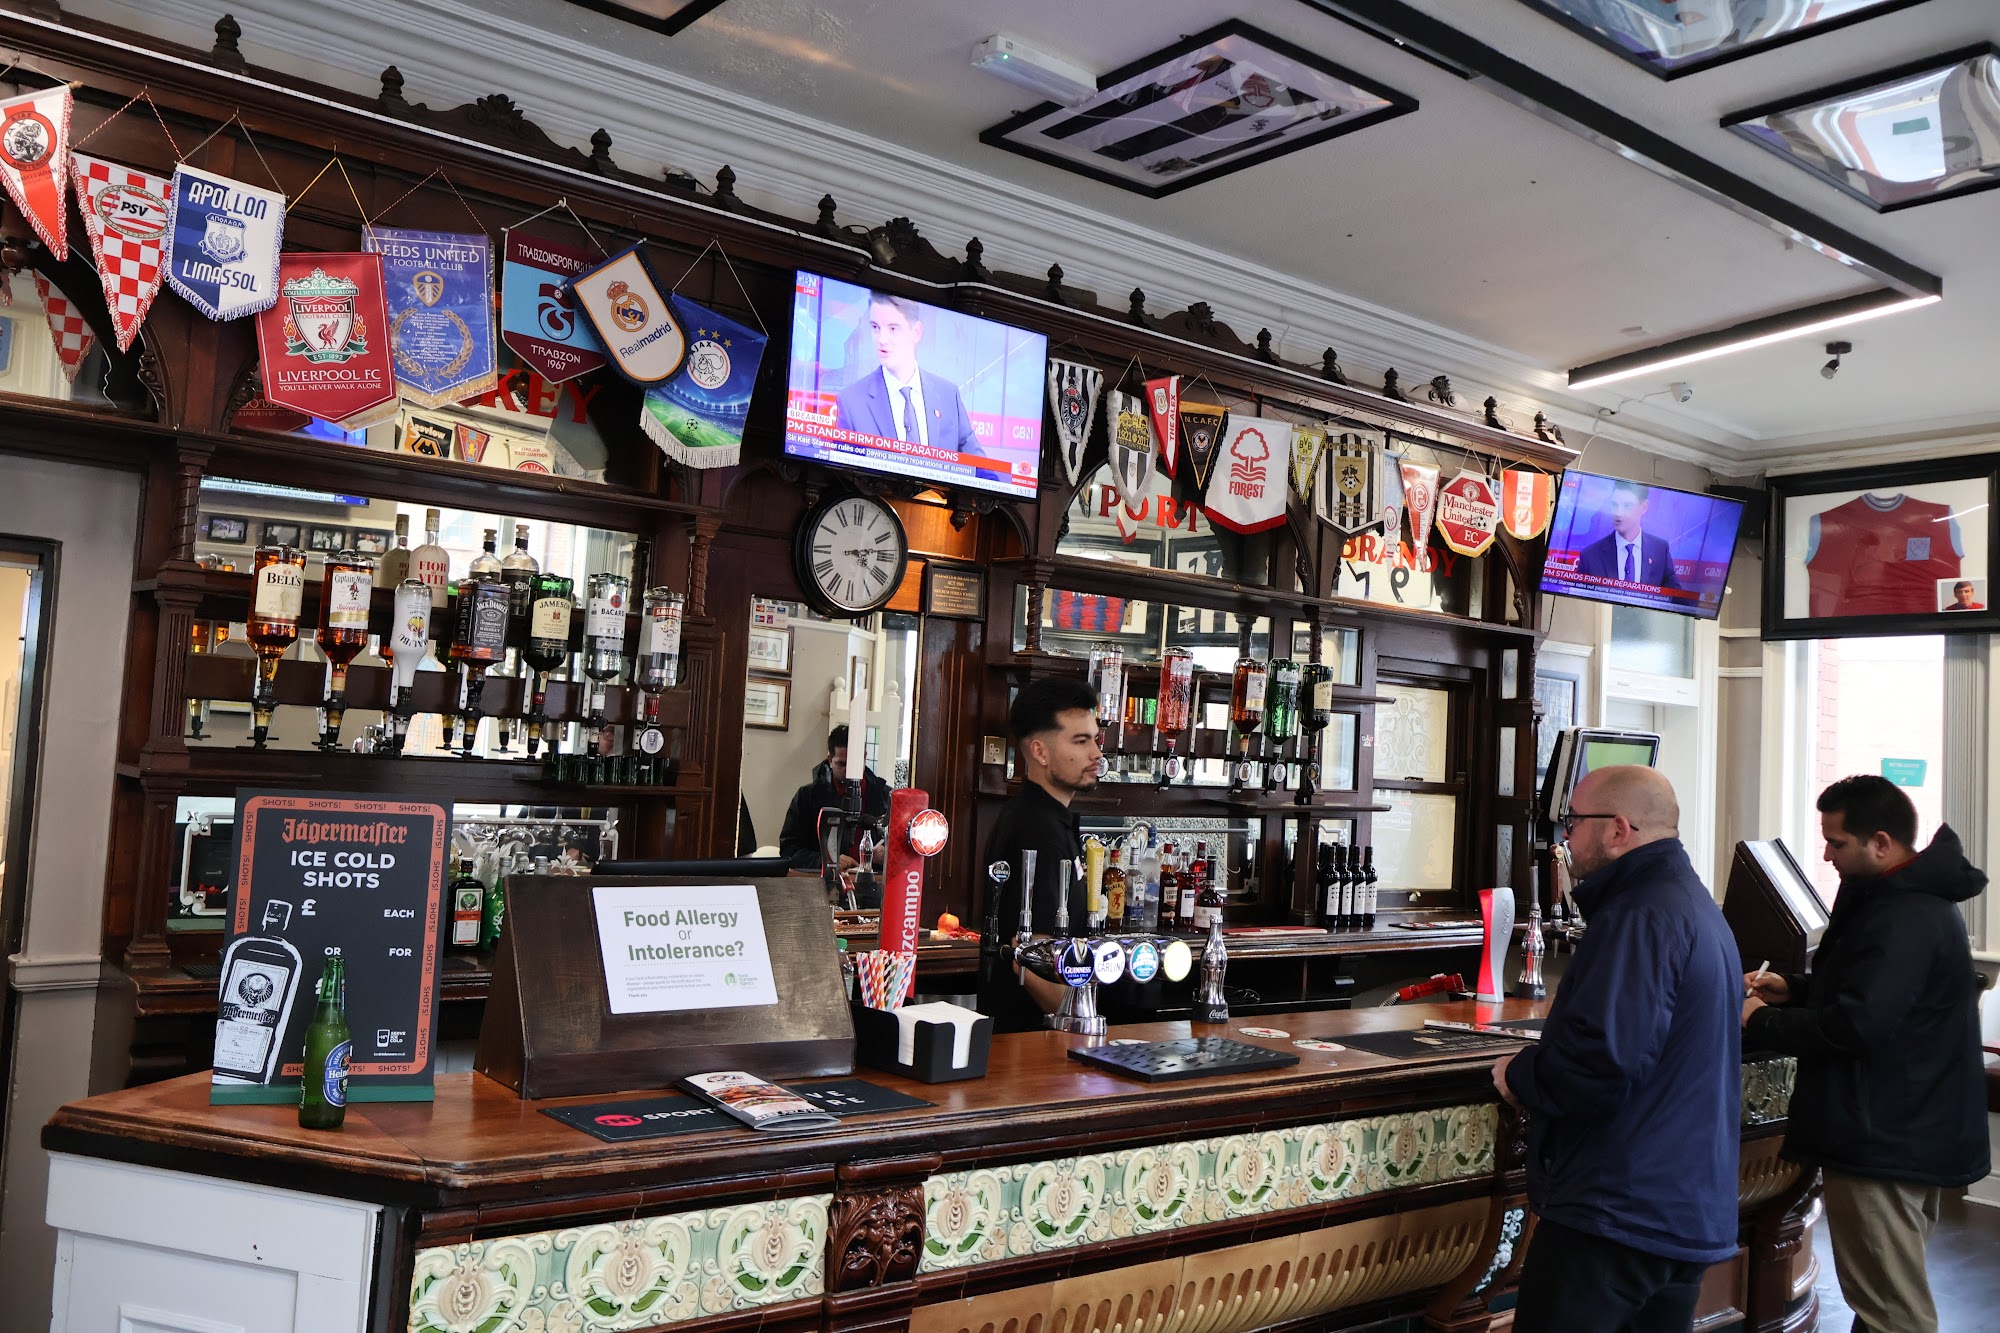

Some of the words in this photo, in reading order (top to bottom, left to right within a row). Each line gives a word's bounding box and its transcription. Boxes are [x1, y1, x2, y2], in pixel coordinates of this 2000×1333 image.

[188, 181, 268, 220] APOLLON
[120, 201, 149, 217] PSV
[376, 244, 420, 259] LEEDS
[425, 248, 480, 263] UNITED
[518, 244, 573, 272] TRABZONSPOR
[393, 258, 438, 270] FOOTBALL
[440, 262, 464, 272] CLUB
[182, 259, 258, 292] LIMASSOL
[803, 287, 815, 295] LIVE
[295, 303, 350, 313] LIVERPOOL
[620, 321, 673, 359] Realmadrid
[531, 344, 581, 364] TRABZON
[547, 359, 566, 370] 1967
[278, 370, 360, 382] LIVERPOOL
[365, 369, 381, 380] FC
[790, 410, 830, 424] BREAKING
[1012, 425, 1034, 440] GBN
[1118, 429, 1132, 441] 1921
[787, 420, 804, 432] PM
[806, 424, 847, 440] STANDS
[849, 433, 874, 445] FIRM
[875, 437, 891, 447] ON
[893, 441, 959, 462] REPARATIONS
[1137, 434, 1149, 447] 2011
[1299, 437, 1313, 451] BVB
[787, 433, 797, 442] Sir
[798, 436, 811, 444] Keir
[811, 437, 838, 450] Starmer
[838, 443, 854, 453] rules
[855, 446, 866, 454] out
[866, 447, 887, 460] paying
[888, 452, 909, 464] slavery
[909, 456, 943, 469] reparations
[944, 463, 950, 471] at
[951, 464, 972, 475] summit
[1016, 487, 1031, 496] 16:12
[1099, 483, 1201, 533] PORT
[1443, 493, 1494, 518] Manchester
[1443, 507, 1473, 526] United
[419, 561, 447, 572] FIOR
[1546, 561, 1574, 571] BREAKING
[267, 572, 301, 586] BELL'S
[334, 573, 356, 584] Captain
[419, 574, 446, 586] VITE
[1543, 567, 1555, 576] PM
[1555, 570, 1584, 581] STANDS
[1584, 574, 1602, 584] FIRM
[1603, 577, 1613, 586] ON
[1614, 580, 1661, 593] REPARATIONS
[1558, 579, 1575, 587] Starmer
[1595, 585, 1609, 593] paying
[1609, 587, 1624, 595] slavery
[1625, 589, 1648, 599] reparations
[476, 600, 489, 612] JACK
[262, 798, 296, 807] SHOTS!
[308, 800, 341, 809] SHOTS!
[354, 802, 386, 811] SHOTS!
[398, 804, 431, 813] SHOTS!
[244, 811, 254, 843] SHOTS!
[290, 850, 327, 867] ICE
[333, 851, 396, 869] COLD
[241, 854, 251, 886] SHOTS!
[433, 860, 441, 891] SHOTS!
[302, 871, 380, 889] SHOTS
[1095, 857, 1104, 900] STRONGBOW
[237, 898, 247, 930] SHOTS!
[301, 898, 317, 916] £
[383, 908, 415, 918] EACH
[623, 910, 670, 927] Food
[675, 909, 738, 928] Allergy
[678, 929, 692, 941] or
[324, 946, 341, 956] OR
[388, 947, 412, 957] FOR
[628, 940, 744, 961] Intolerance?
[426, 944, 434, 975] SHOTS!
[1064, 966, 1092, 975] GUINNESS
[1096, 962, 1124, 973] CARLING
[418, 1027, 427, 1059] SHOTS!
